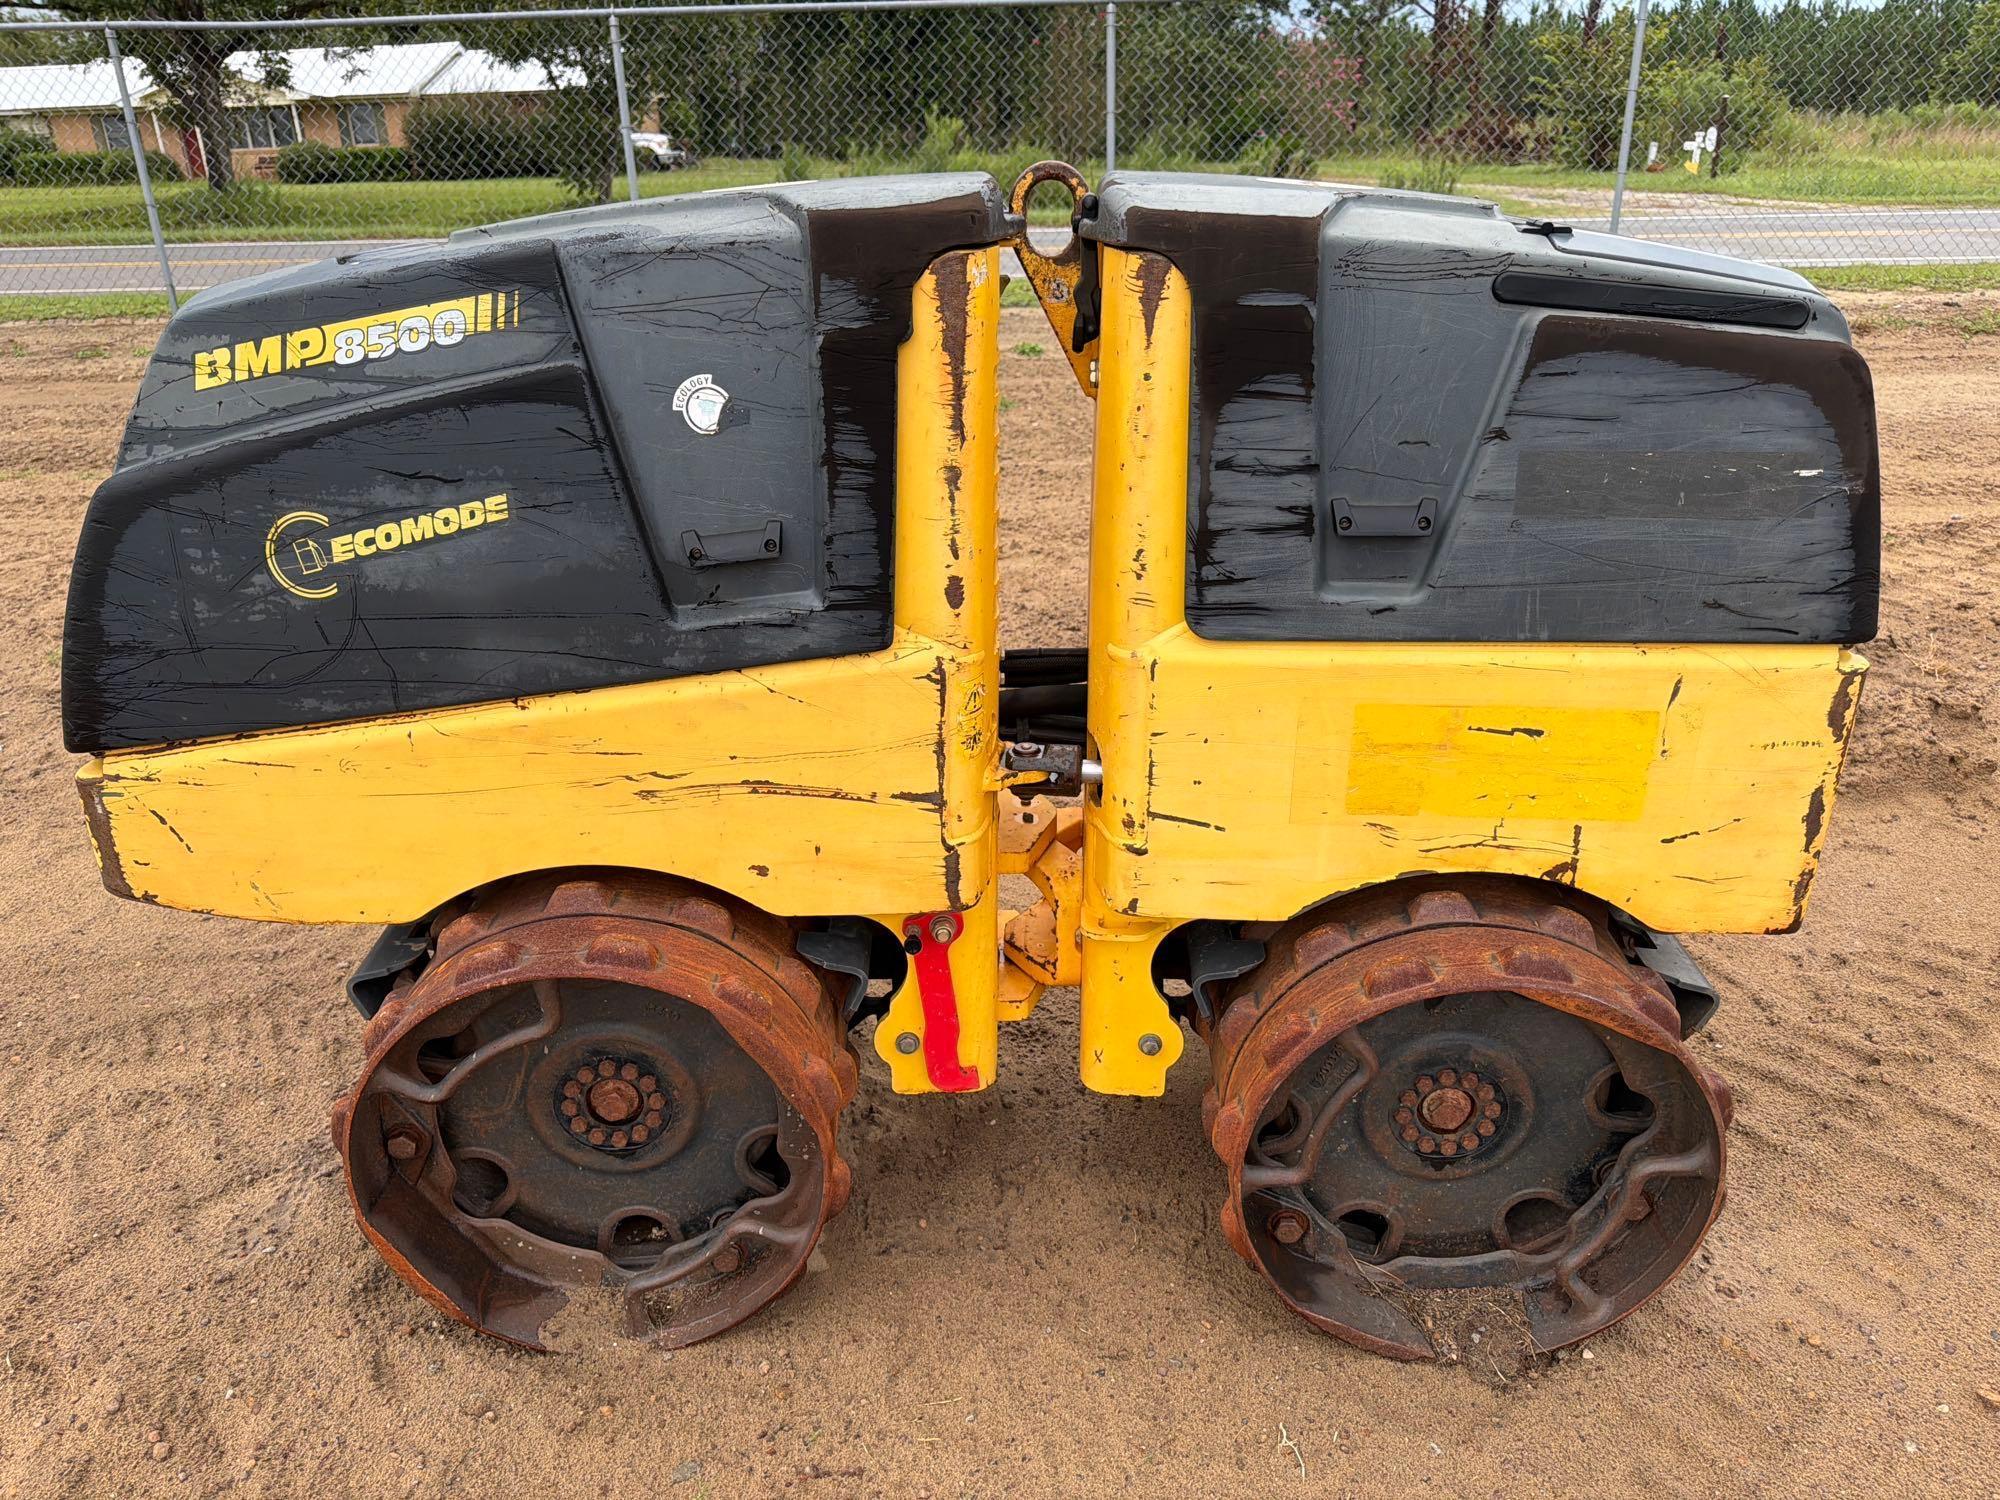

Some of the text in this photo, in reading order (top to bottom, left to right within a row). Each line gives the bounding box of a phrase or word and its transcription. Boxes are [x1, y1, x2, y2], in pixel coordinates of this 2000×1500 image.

[195, 309, 467, 392] BMP 8500
[675, 376, 710, 409] ECOLOGY
[331, 493, 509, 563] ECOMODE
